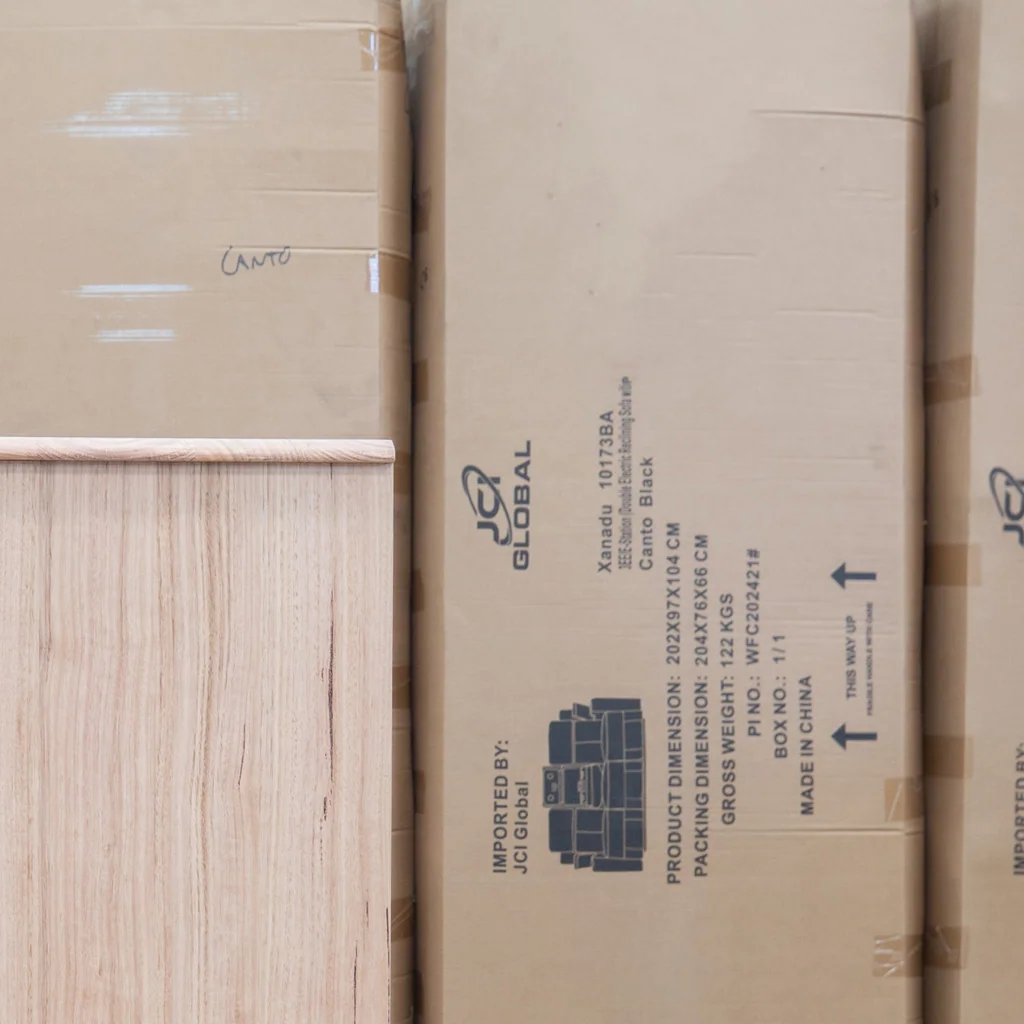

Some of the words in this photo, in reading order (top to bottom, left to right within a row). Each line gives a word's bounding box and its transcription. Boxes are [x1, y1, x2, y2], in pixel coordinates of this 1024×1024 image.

[221, 245, 292, 276] CANTO
[599, 410, 614, 489] 10173BA
[470, 472, 504, 545] JCI
[512, 440, 532, 571] GLOBAL
[639, 456, 654, 507] Black
[597, 504, 613, 573] Xanadu
[639, 516, 654, 571] Canto
[666, 522, 681, 550] CM
[694, 534, 709, 562] CM
[665, 554, 681, 665] 202X97X104
[694, 567, 709, 667] 204X76X66
[719, 593, 734, 632] KGS
[745, 549, 761, 665] WFC202421#
[845, 615, 857, 633] UP
[720, 637, 735, 668] 122
[845, 636, 857, 666] WAY
[748, 675, 762, 715] NO.:
[773, 675, 787, 715] NO.:
[799, 675, 815, 734] CHINA
[845, 669, 857, 700] THIS
[666, 675, 682, 787] DIMENSION:
[694, 675, 709, 787] DIMENSION:
[721, 675, 736, 754] WEIGHT:
[748, 719, 763, 737] PI
[773, 719, 788, 759] BOX
[494, 739, 510, 770] BY:
[800, 739, 815, 757] IN
[513, 781, 530, 840] Global
[721, 758, 737, 826] GROSS
[800, 762, 815, 815] MADE
[492, 775, 510, 874] IMPORTED
[666, 792, 682, 885] PRODUCT
[693, 792, 710, 877] PACKING
[513, 845, 529, 875] JCI
